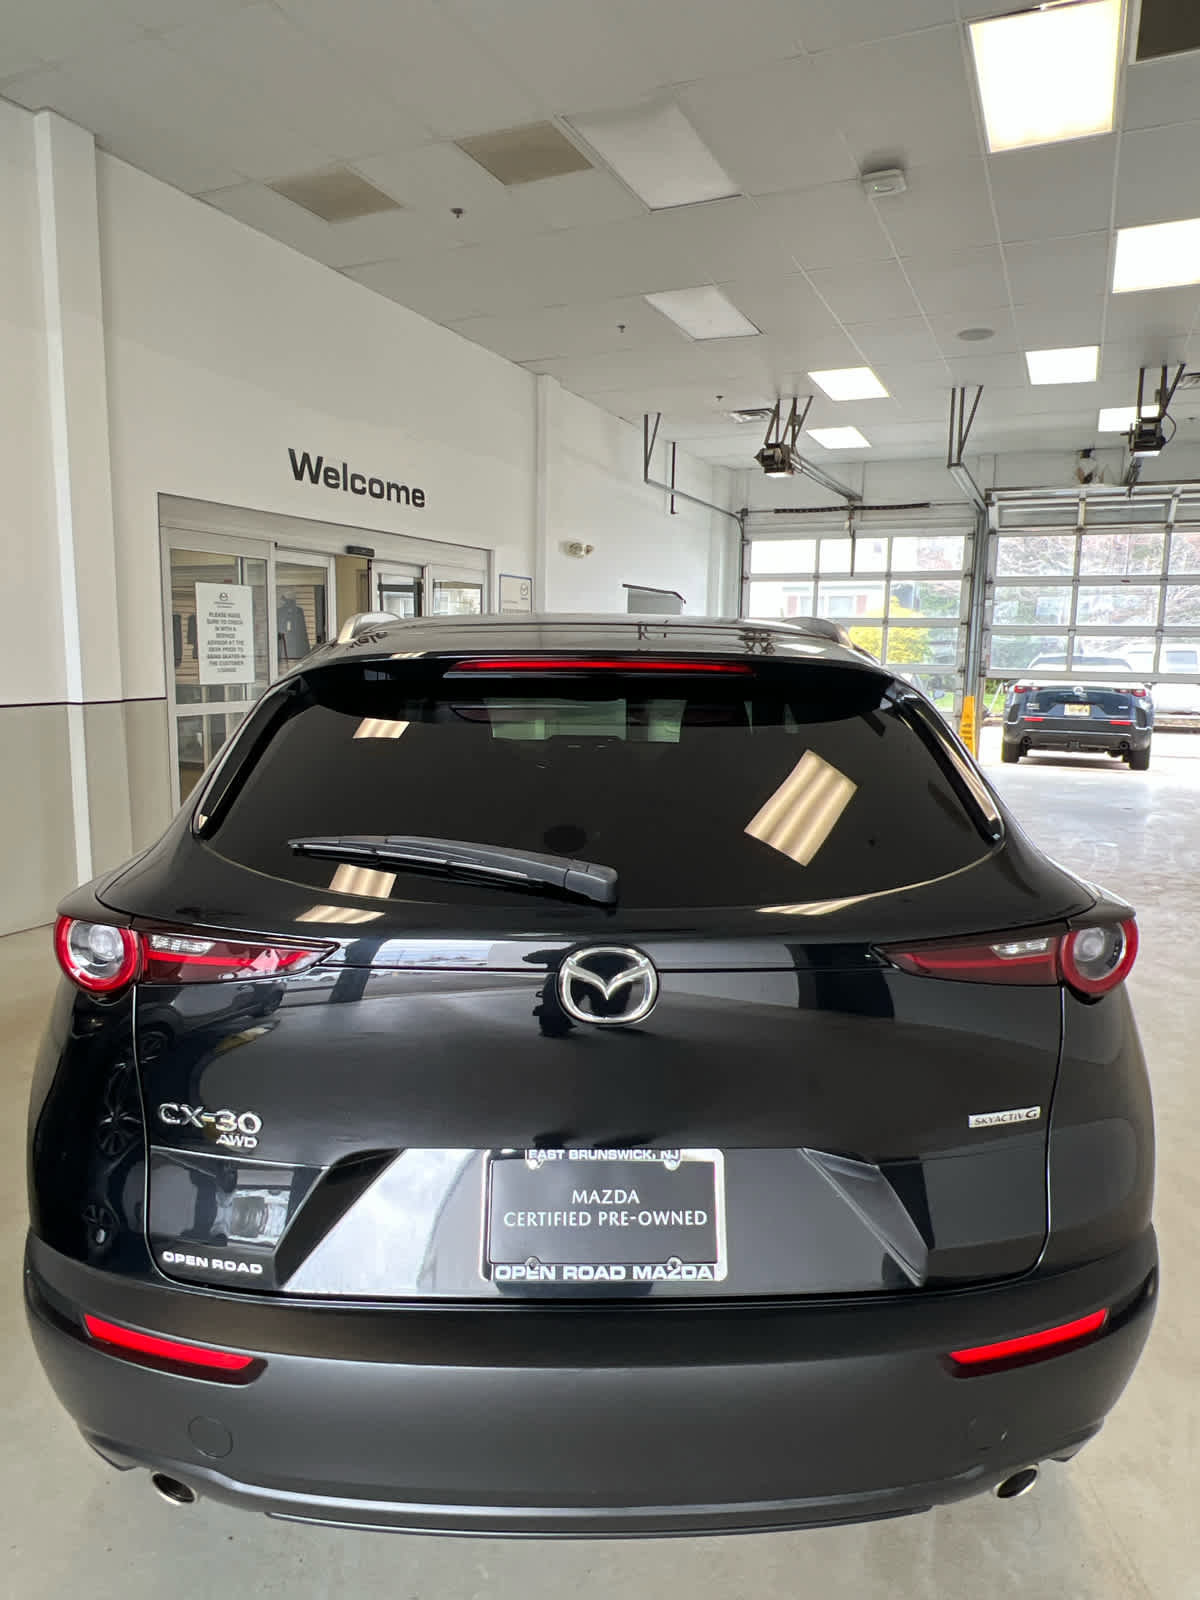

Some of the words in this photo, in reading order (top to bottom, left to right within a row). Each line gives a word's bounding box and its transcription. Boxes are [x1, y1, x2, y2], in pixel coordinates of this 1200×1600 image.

[288, 448, 425, 508] Welcome
[159, 1103, 263, 1134] CX-30
[216, 1133, 258, 1148] AWD
[528, 1149, 565, 1160] EAST
[568, 1149, 656, 1160] BRUNSWICK,
[660, 1150, 679, 1160] NJ
[571, 1189, 640, 1204] MAZDA
[503, 1211, 592, 1227] CERTIFIED
[598, 1210, 708, 1226] PRE-OWNED
[162, 1251, 208, 1268] OPEN
[211, 1258, 263, 1275] ROAD
[495, 1265, 556, 1281] OPEN
[562, 1265, 626, 1281] ROAD
[632, 1265, 713, 1281] MAZDA
